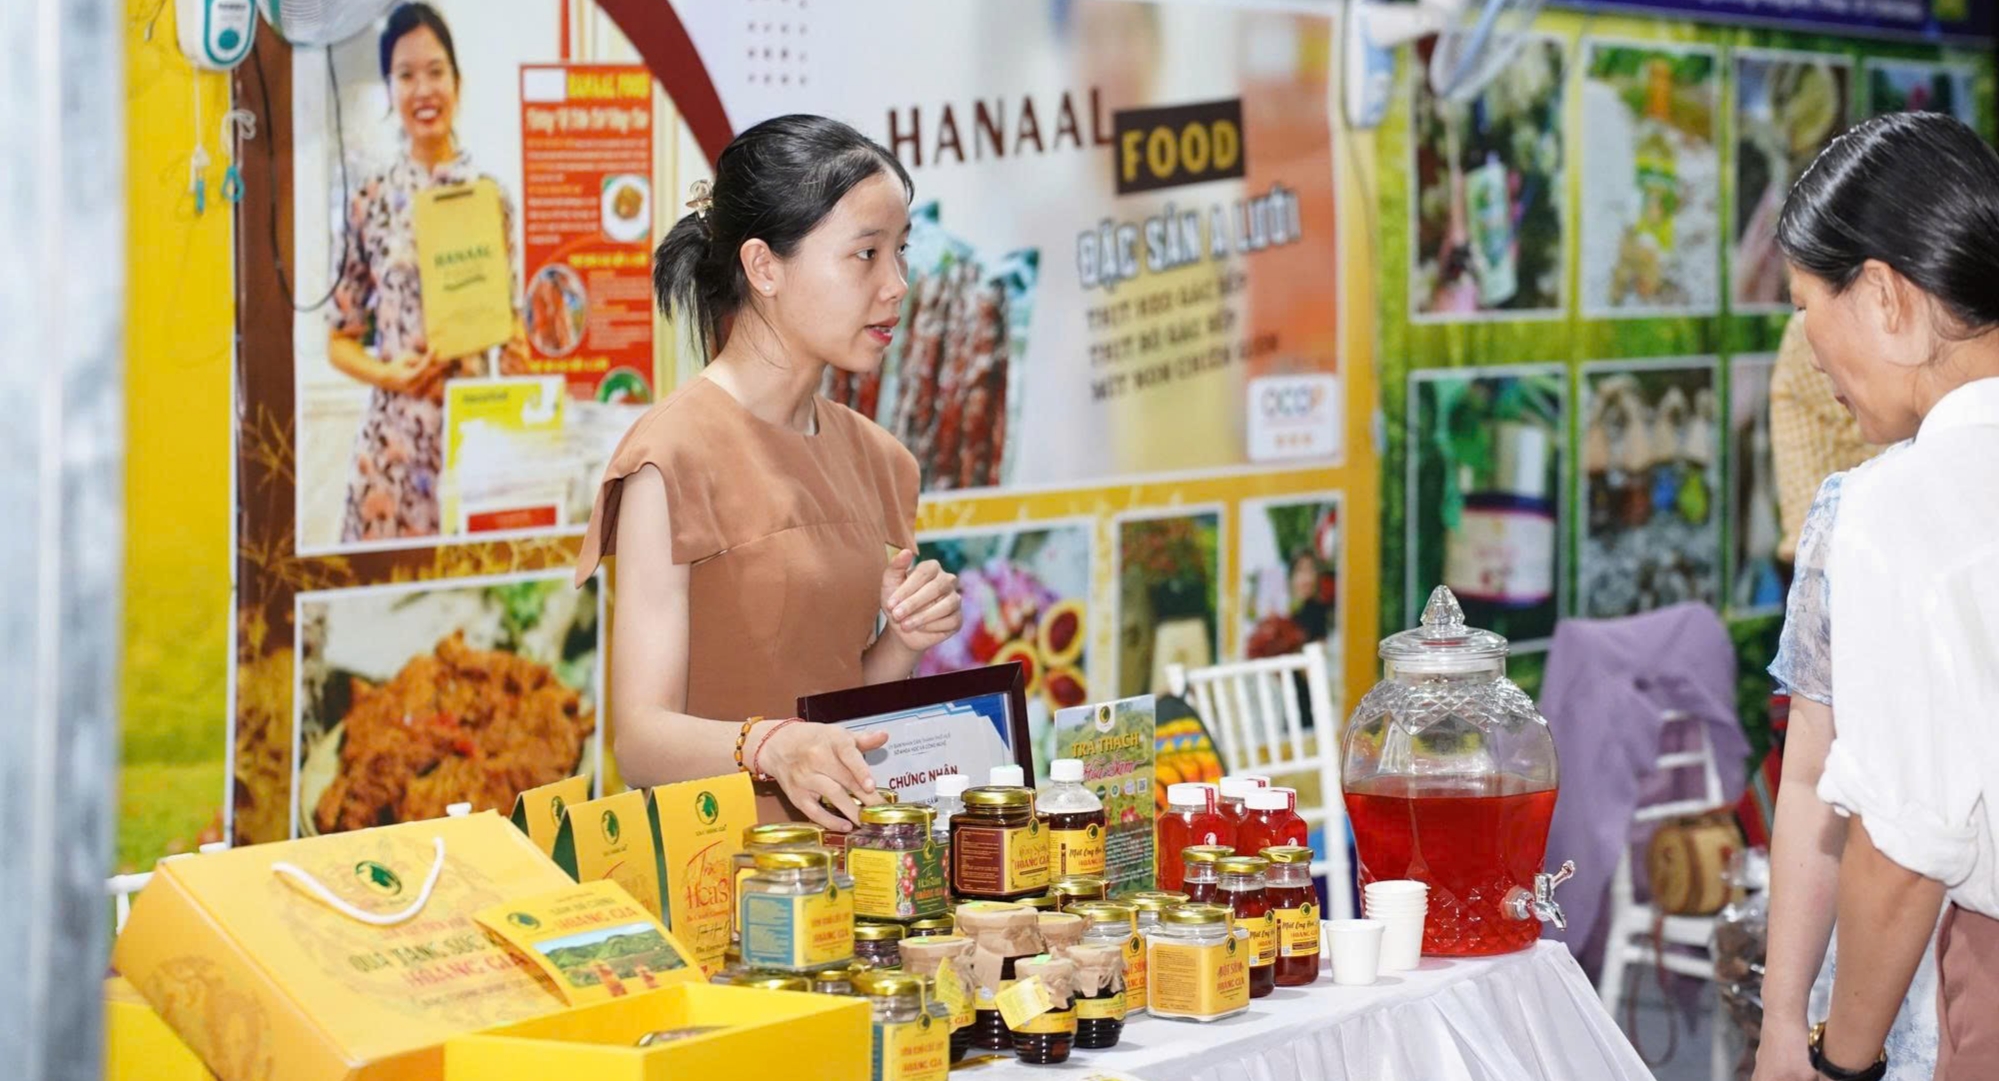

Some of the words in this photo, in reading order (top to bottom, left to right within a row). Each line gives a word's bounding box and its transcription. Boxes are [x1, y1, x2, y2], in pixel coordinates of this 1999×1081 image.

[887, 87, 1115, 169] HANAAL
[1120, 118, 1241, 183] FOOD
[1209, 203, 1229, 260] A
[888, 770, 926, 790] CHỨNG
